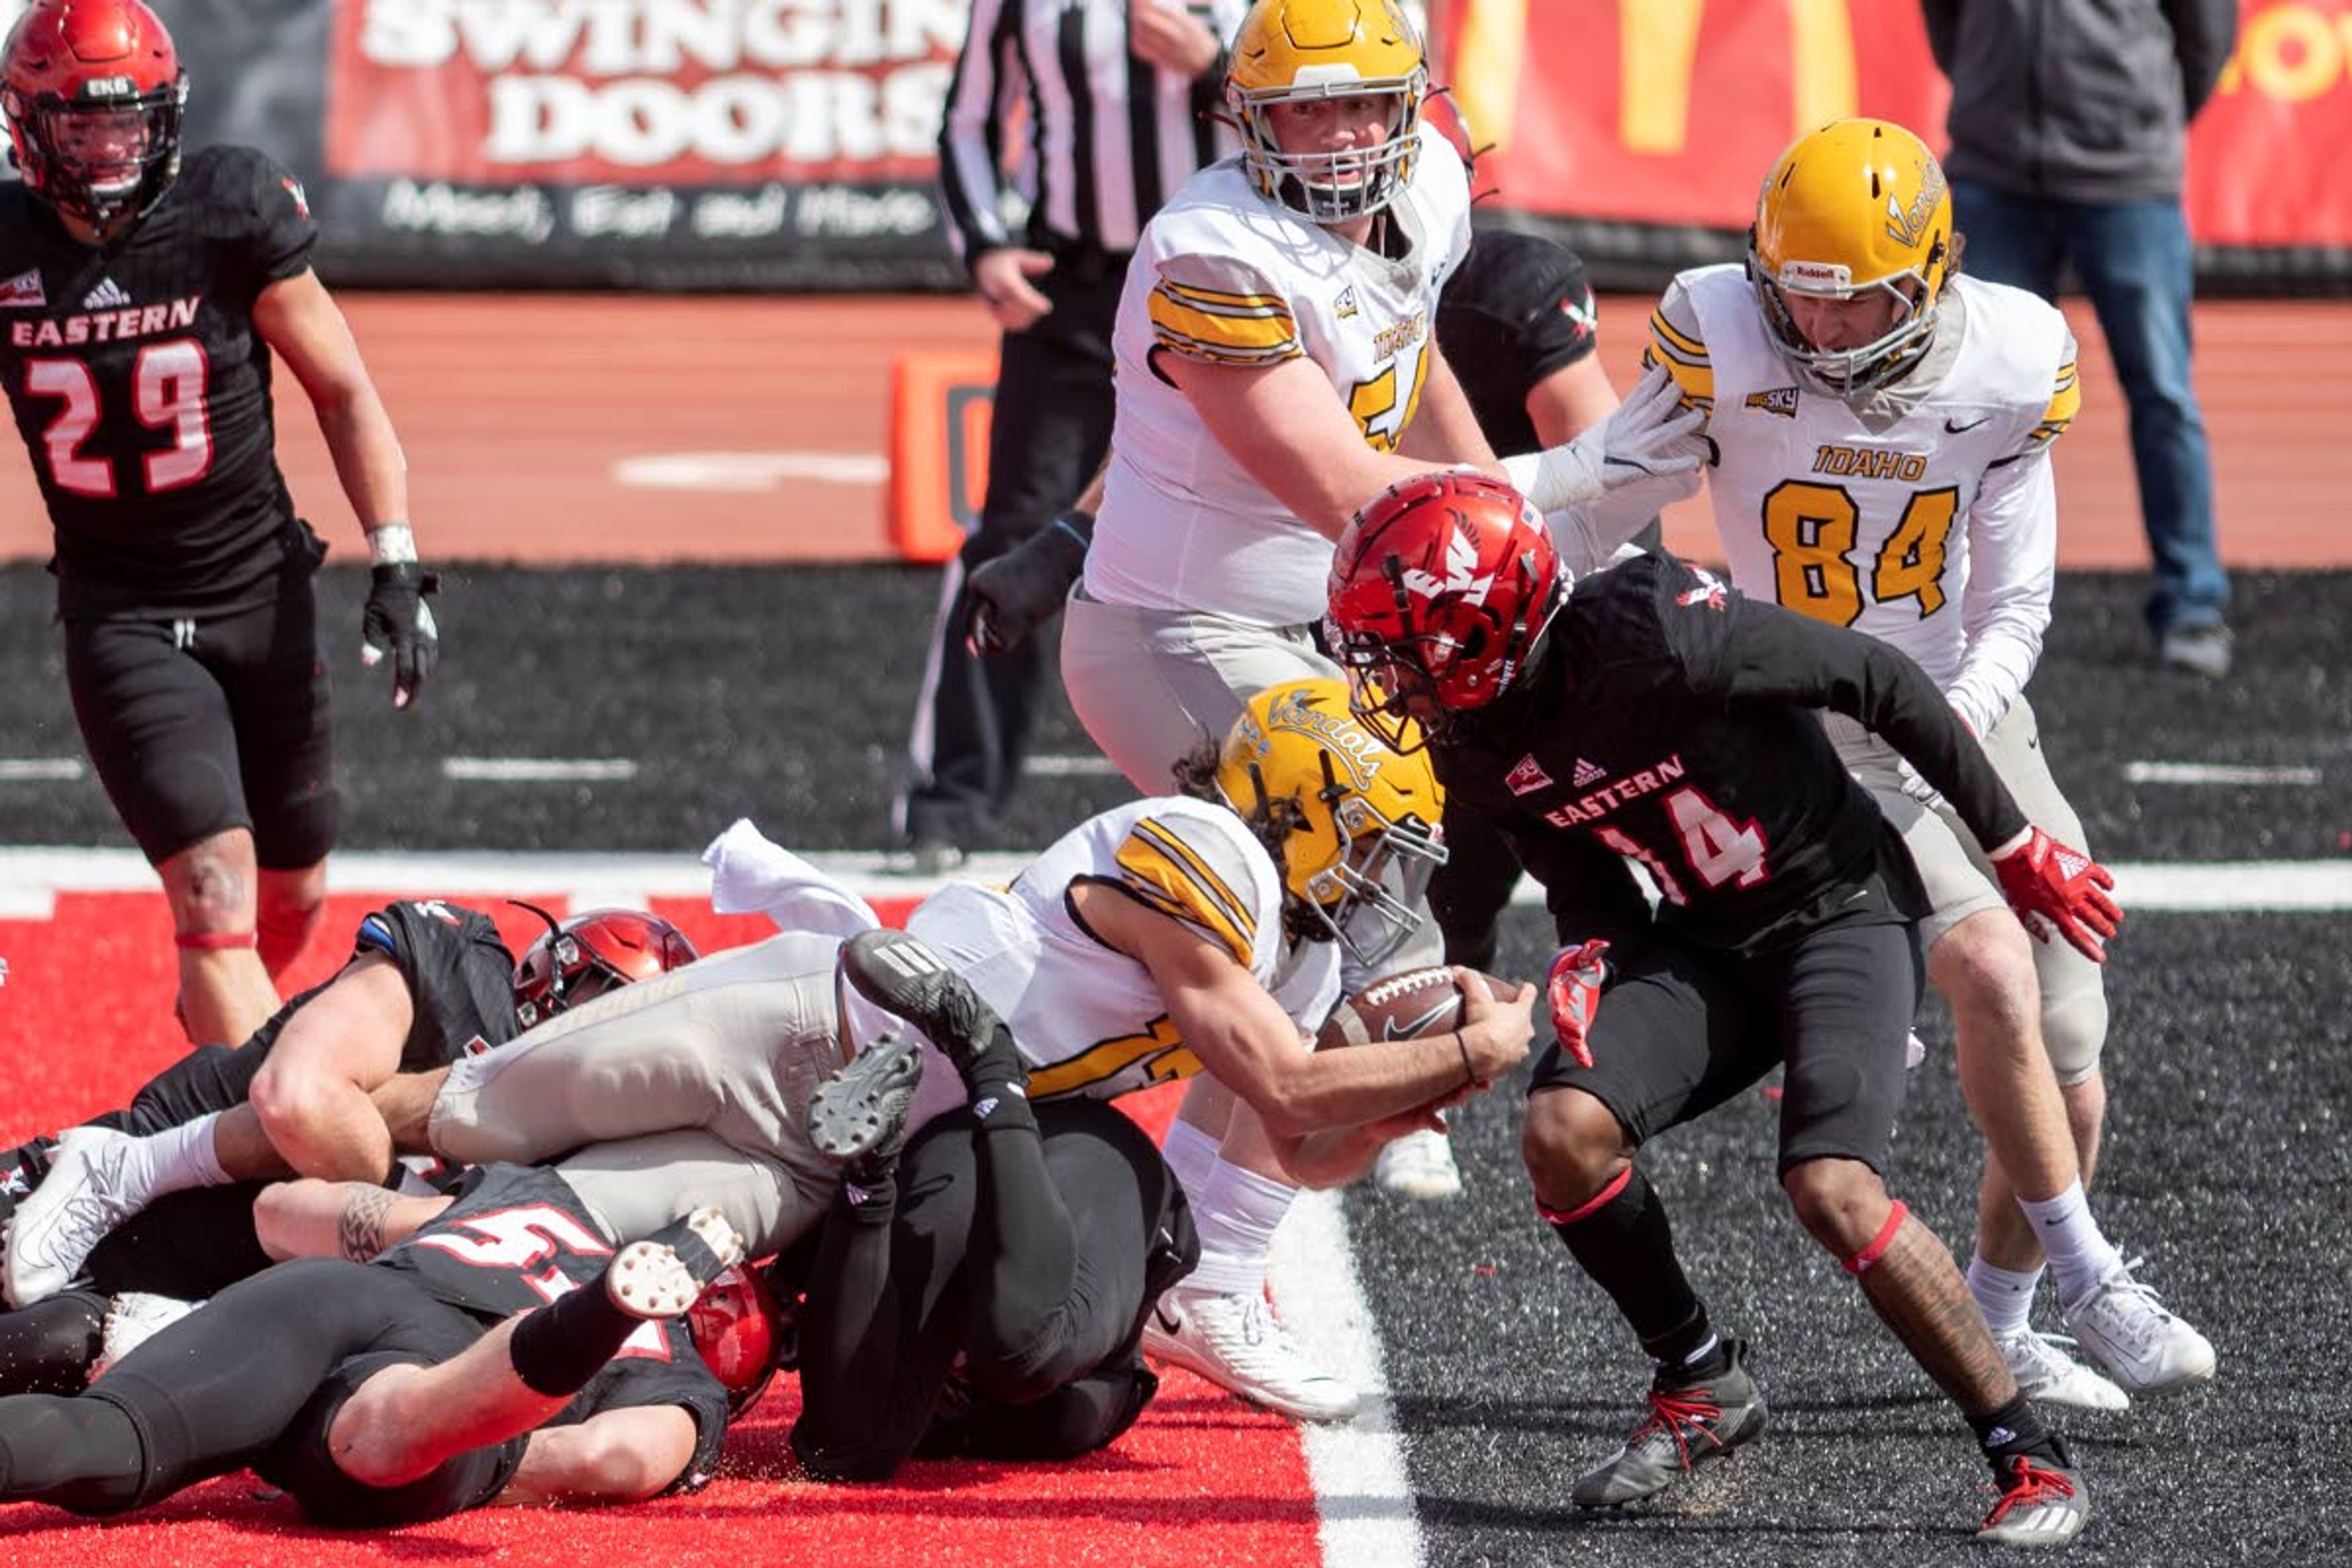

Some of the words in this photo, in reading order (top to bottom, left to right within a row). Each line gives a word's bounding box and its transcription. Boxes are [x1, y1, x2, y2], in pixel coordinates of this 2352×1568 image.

[485, 69, 948, 167] DOORS
[1796, 266, 1834, 279] Riddell
[11, 294, 202, 347] EASTERN
[26, 337, 213, 496] 29
[1812, 445, 1928, 481] IDAHO
[1762, 478, 1960, 628] 84
[1268, 690, 1381, 781] Vandals
[1544, 753, 1686, 829] EASTERN
[1594, 783, 1771, 908] 14
